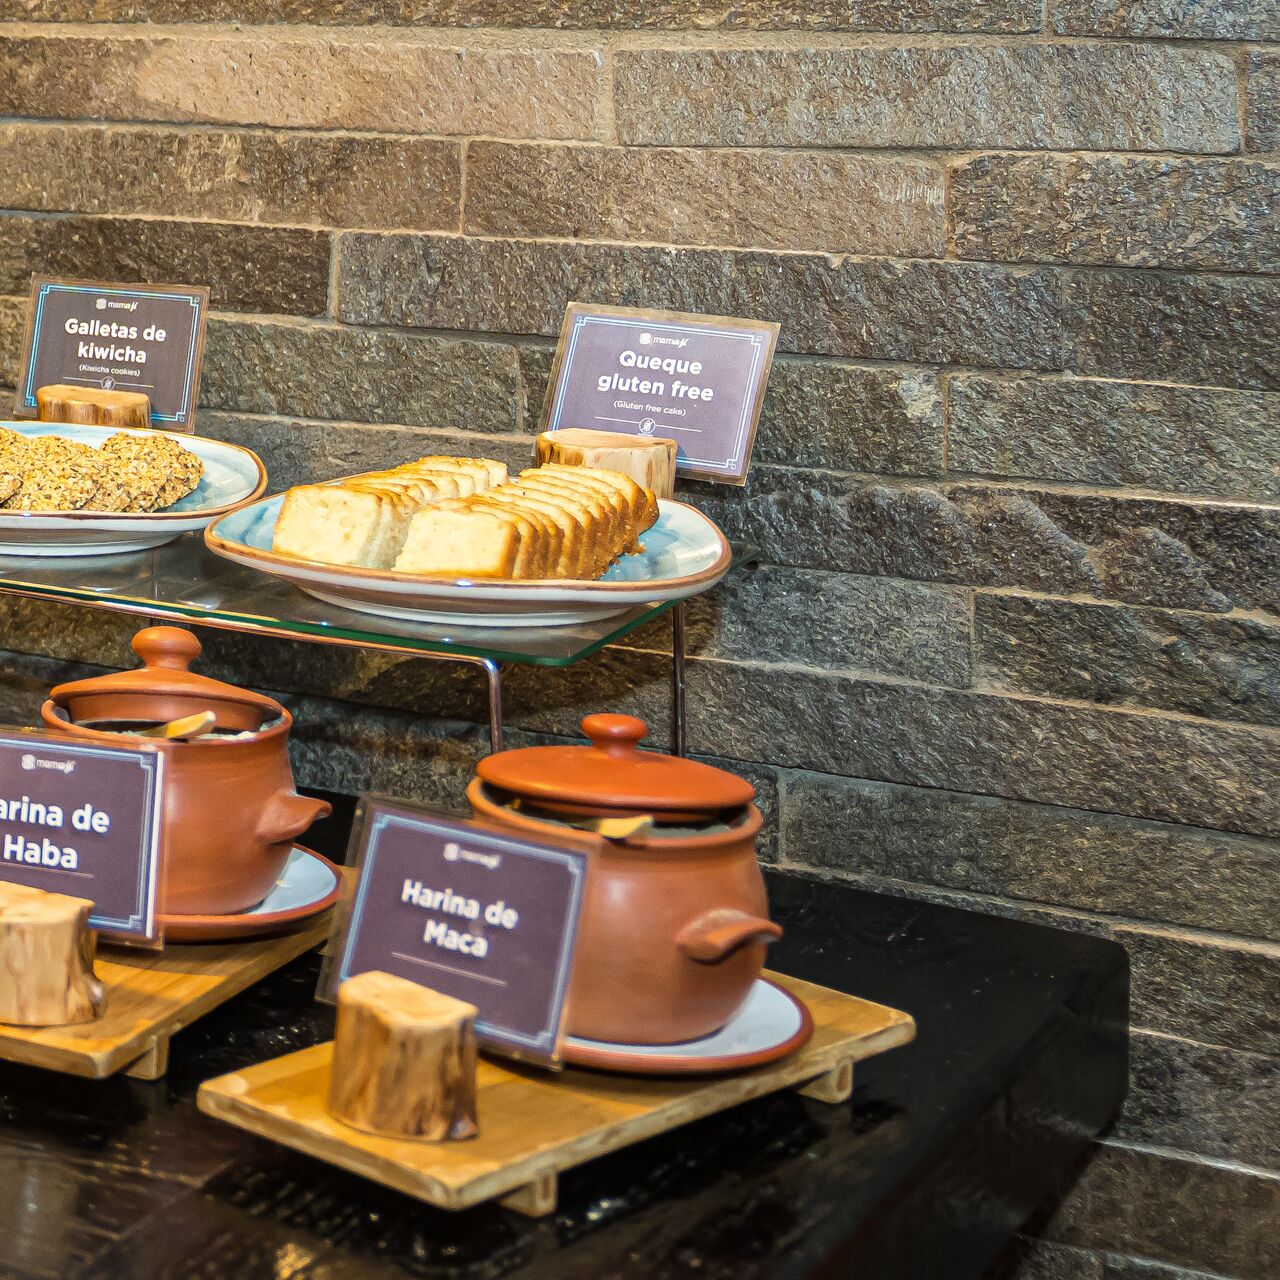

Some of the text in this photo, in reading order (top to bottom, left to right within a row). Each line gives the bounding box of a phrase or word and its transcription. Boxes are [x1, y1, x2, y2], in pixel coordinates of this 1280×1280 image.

[64, 317, 166, 341] Galletas de
[77, 341, 146, 362] kiwicha
[619, 350, 702, 374] Queque
[78, 363, 140, 376] (Kiwicha cookies)
[597, 373, 713, 401] gluten free
[613, 400, 686, 416] (Gluten free cake)
[71, 803, 110, 832] de
[3, 833, 77, 868] Haba
[401, 878, 518, 929] Harina de
[423, 918, 488, 958] Maca
